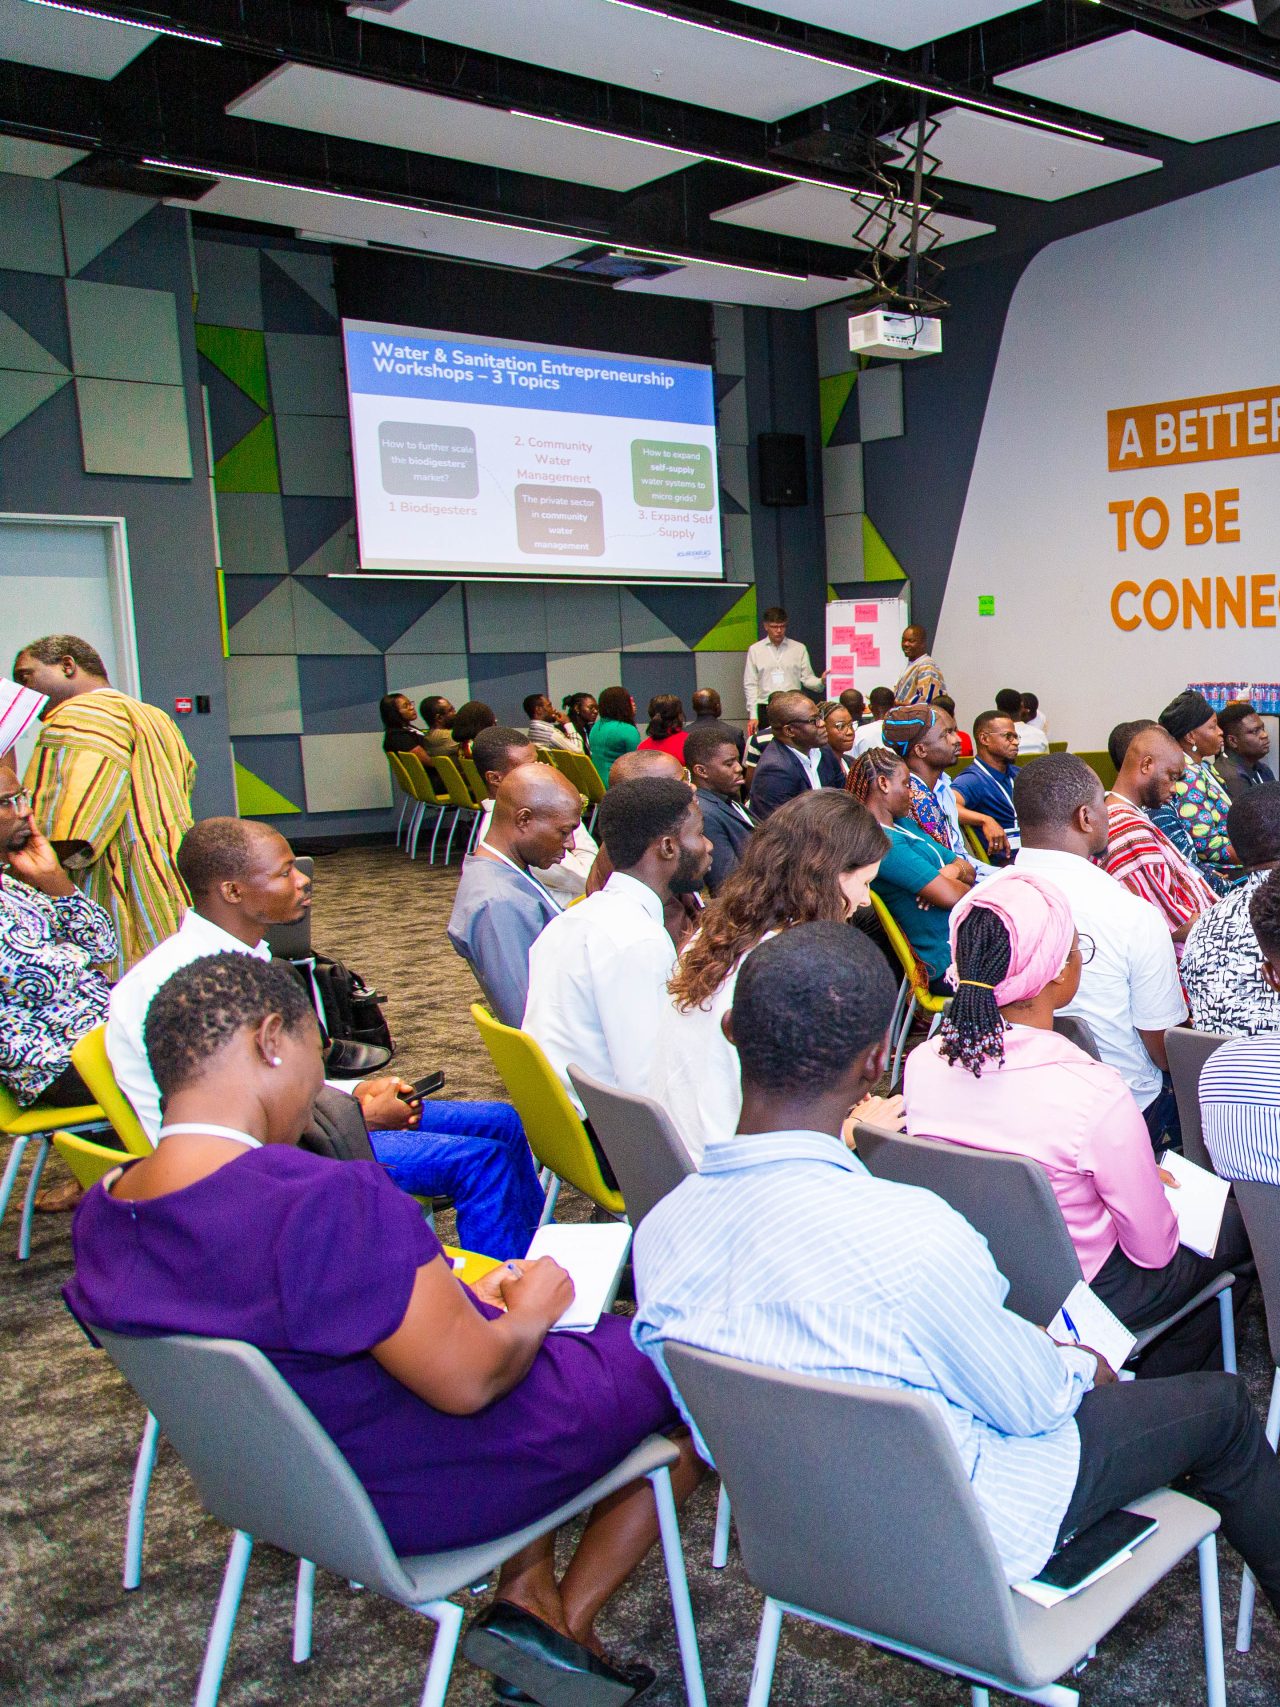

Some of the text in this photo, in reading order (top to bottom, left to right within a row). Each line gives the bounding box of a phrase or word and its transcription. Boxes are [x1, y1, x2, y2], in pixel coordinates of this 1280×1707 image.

[372, 341, 674, 389] Water & Sanitation Entrepreneurship
[372, 357, 474, 383] Workshops
[492, 370, 503, 384] 3
[507, 371, 560, 390] Topics
[514, 436, 593, 453] 2. Community
[1118, 418, 1144, 461] A
[382, 439, 474, 454] How to further scale
[391, 456, 407, 464] the
[535, 453, 572, 466] Water
[642, 448, 700, 461] How to expand
[650, 463, 695, 475] self-supply
[517, 468, 592, 484] Management
[641, 478, 706, 489] water systems to
[522, 494, 595, 507] The private sector
[651, 493, 673, 501] micro
[400, 501, 478, 516] Biodigesters
[541, 511, 588, 522] community
[638, 510, 713, 524] 3. Expand Self
[1108, 488, 1241, 552] TO BE
[548, 527, 574, 535] water
[659, 527, 695, 539] Supply
[534, 541, 589, 550] management
